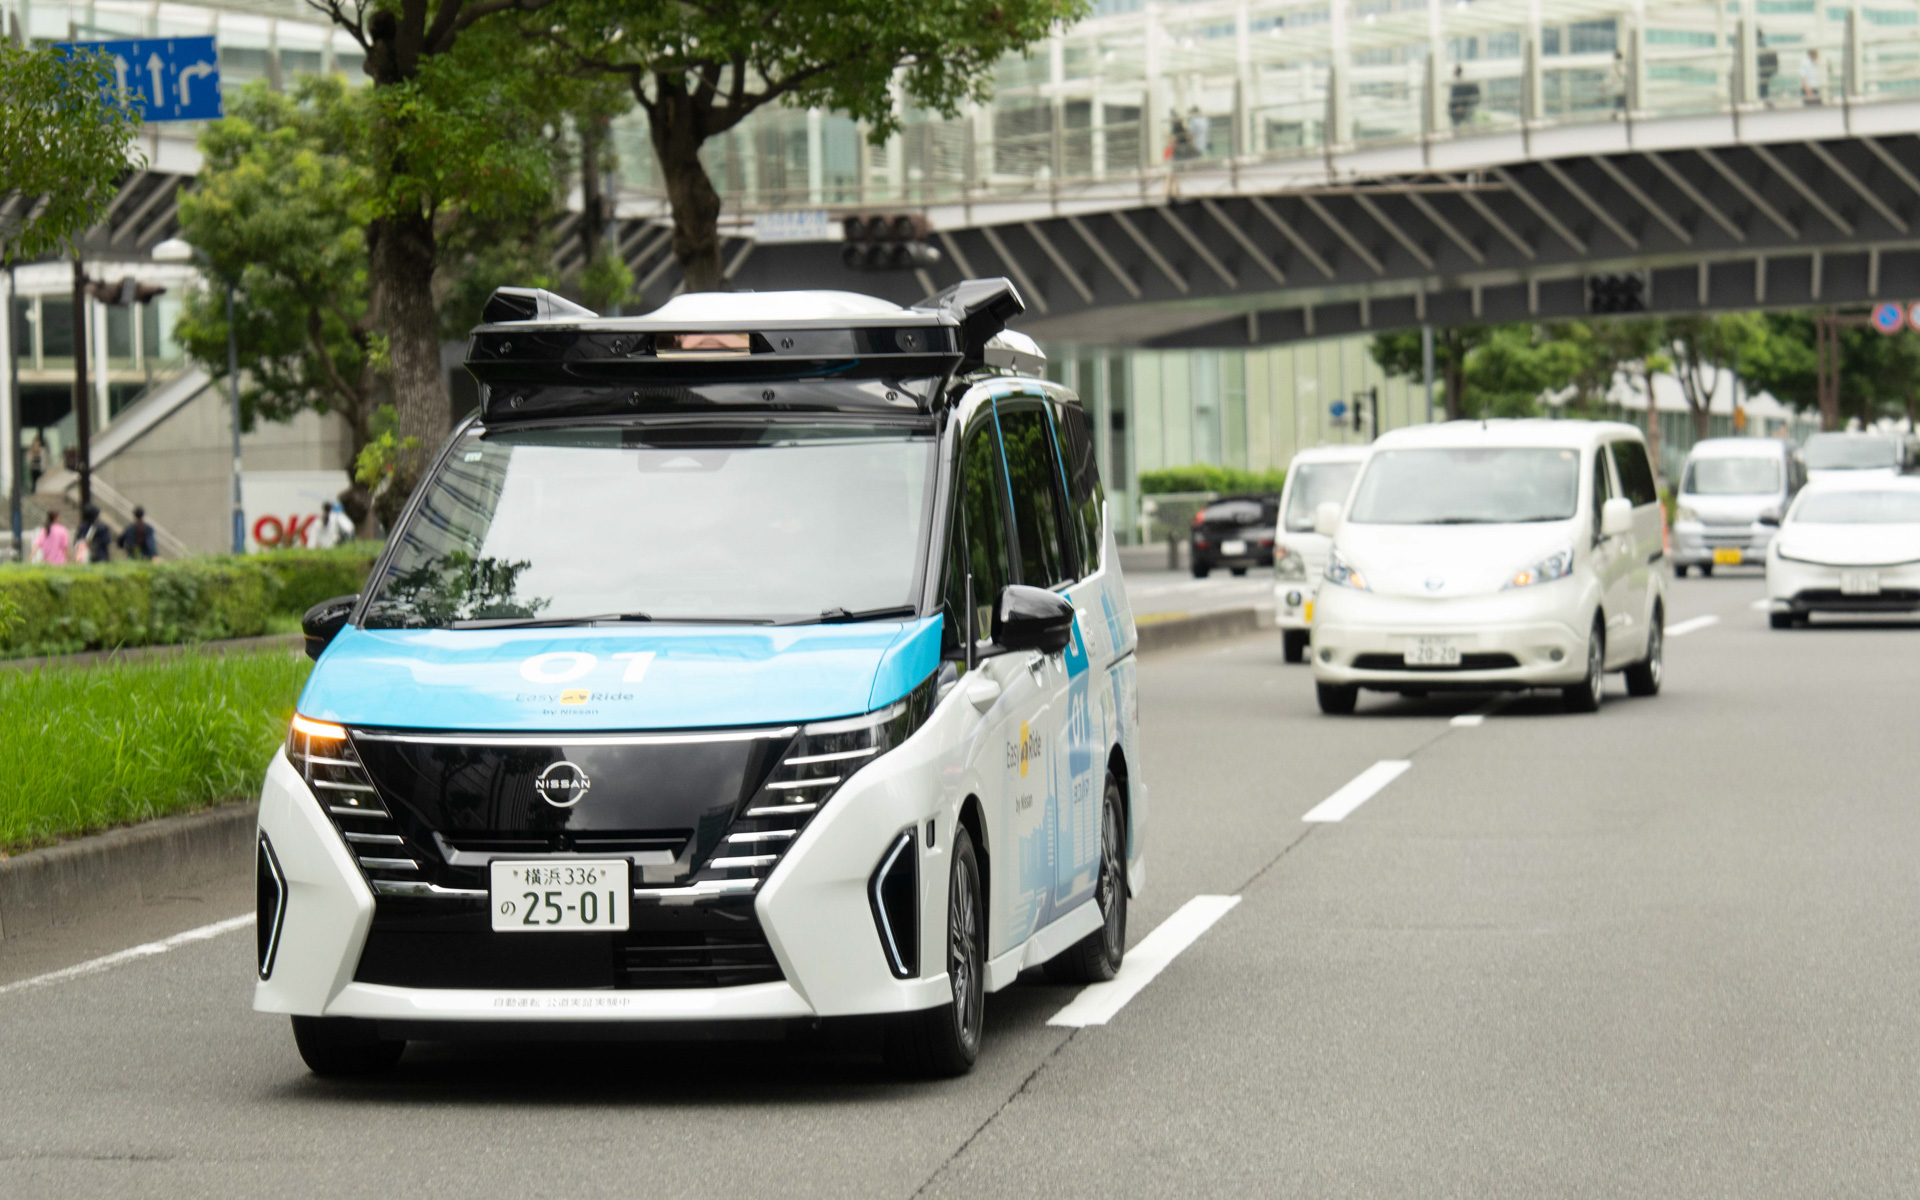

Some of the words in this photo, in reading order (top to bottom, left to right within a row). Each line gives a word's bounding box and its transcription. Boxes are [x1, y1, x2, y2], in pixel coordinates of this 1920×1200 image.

[519, 651, 656, 683] 01
[515, 692, 559, 703] Easy
[591, 692, 634, 701] Ride
[1007, 741, 1019, 772] Easy
[1029, 730, 1042, 761] Ride
[535, 779, 591, 789] NISSAN
[501, 901, 516, 915] の
[522, 891, 615, 925] 25-01
